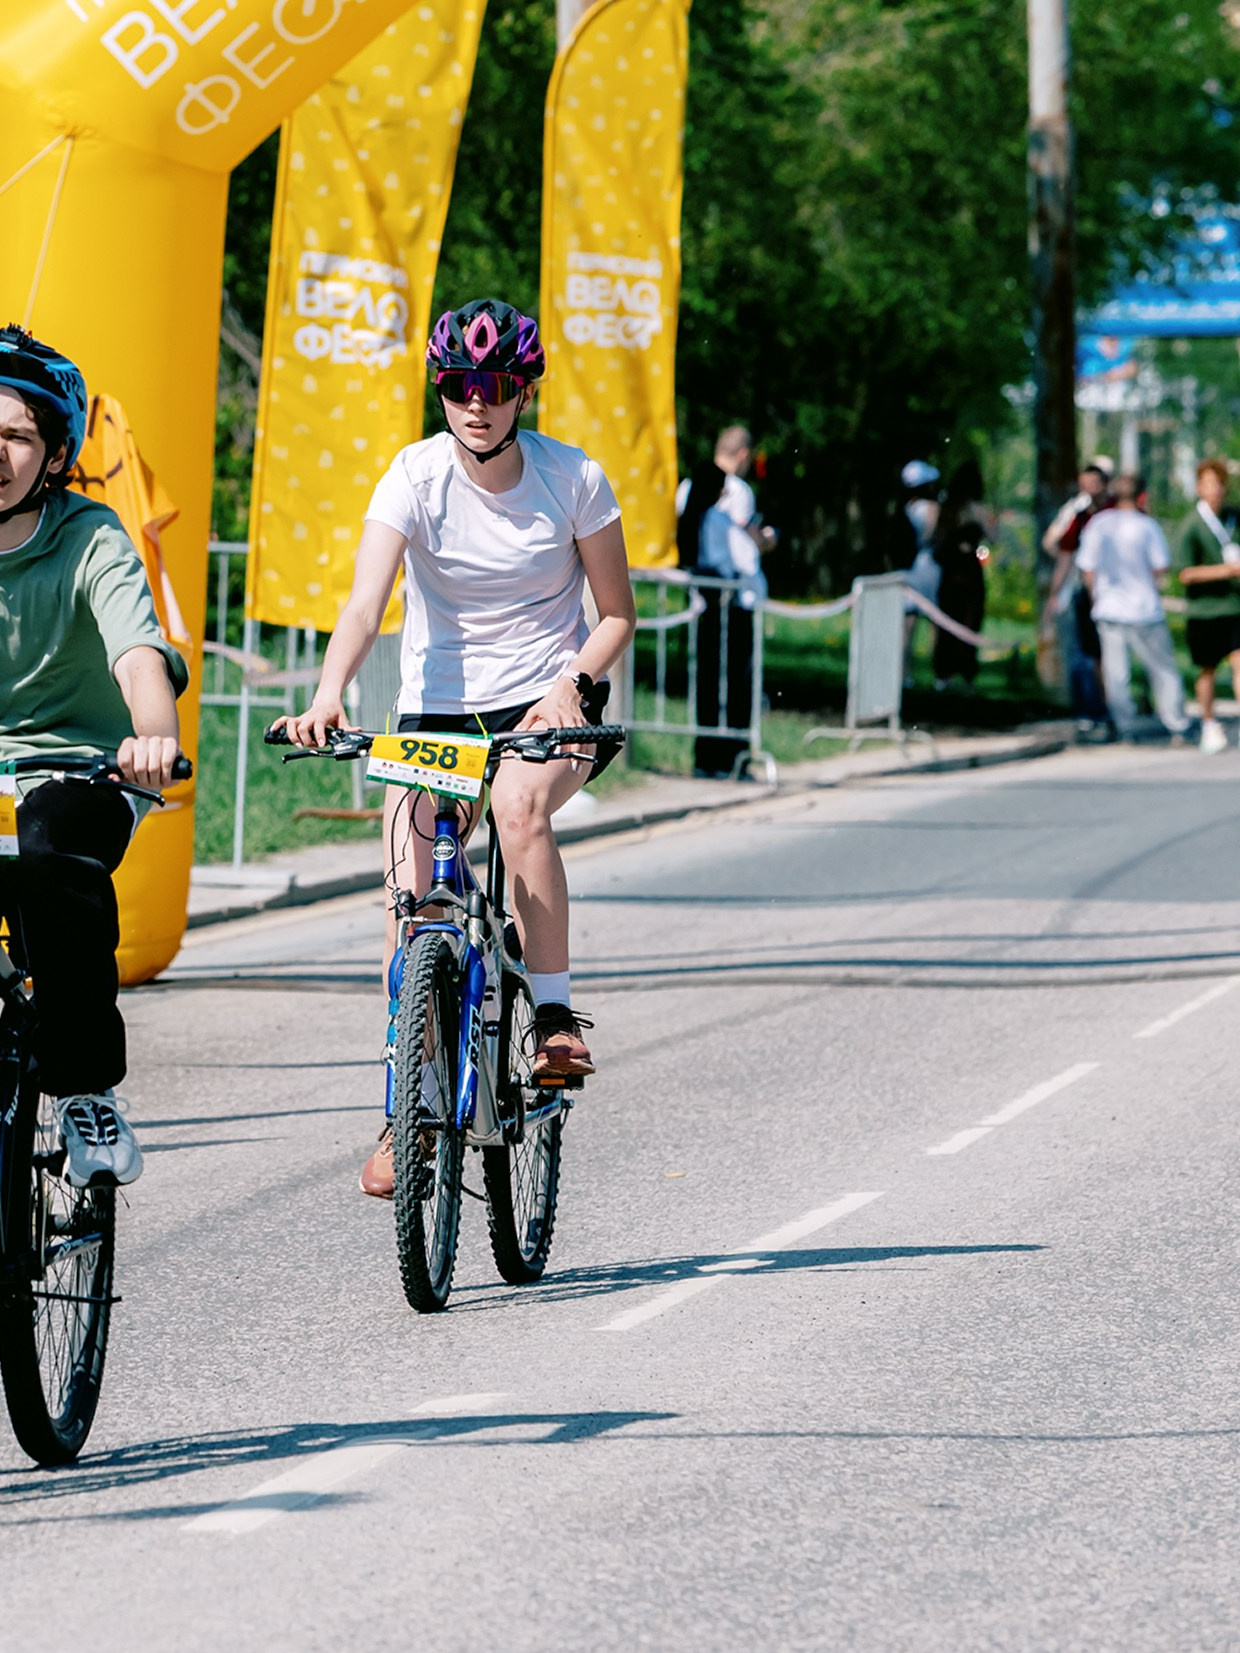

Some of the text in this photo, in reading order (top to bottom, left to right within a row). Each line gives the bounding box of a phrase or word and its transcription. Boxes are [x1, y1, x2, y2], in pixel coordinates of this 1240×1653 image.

[100, 0, 238, 89] ВЕ
[176, 0, 365, 135] ФЕС
[296, 277, 409, 332] ВЕЛО
[564, 273, 662, 315] ВЕЛО
[400, 739, 459, 770] 958
[468, 1003, 483, 1074] RST
